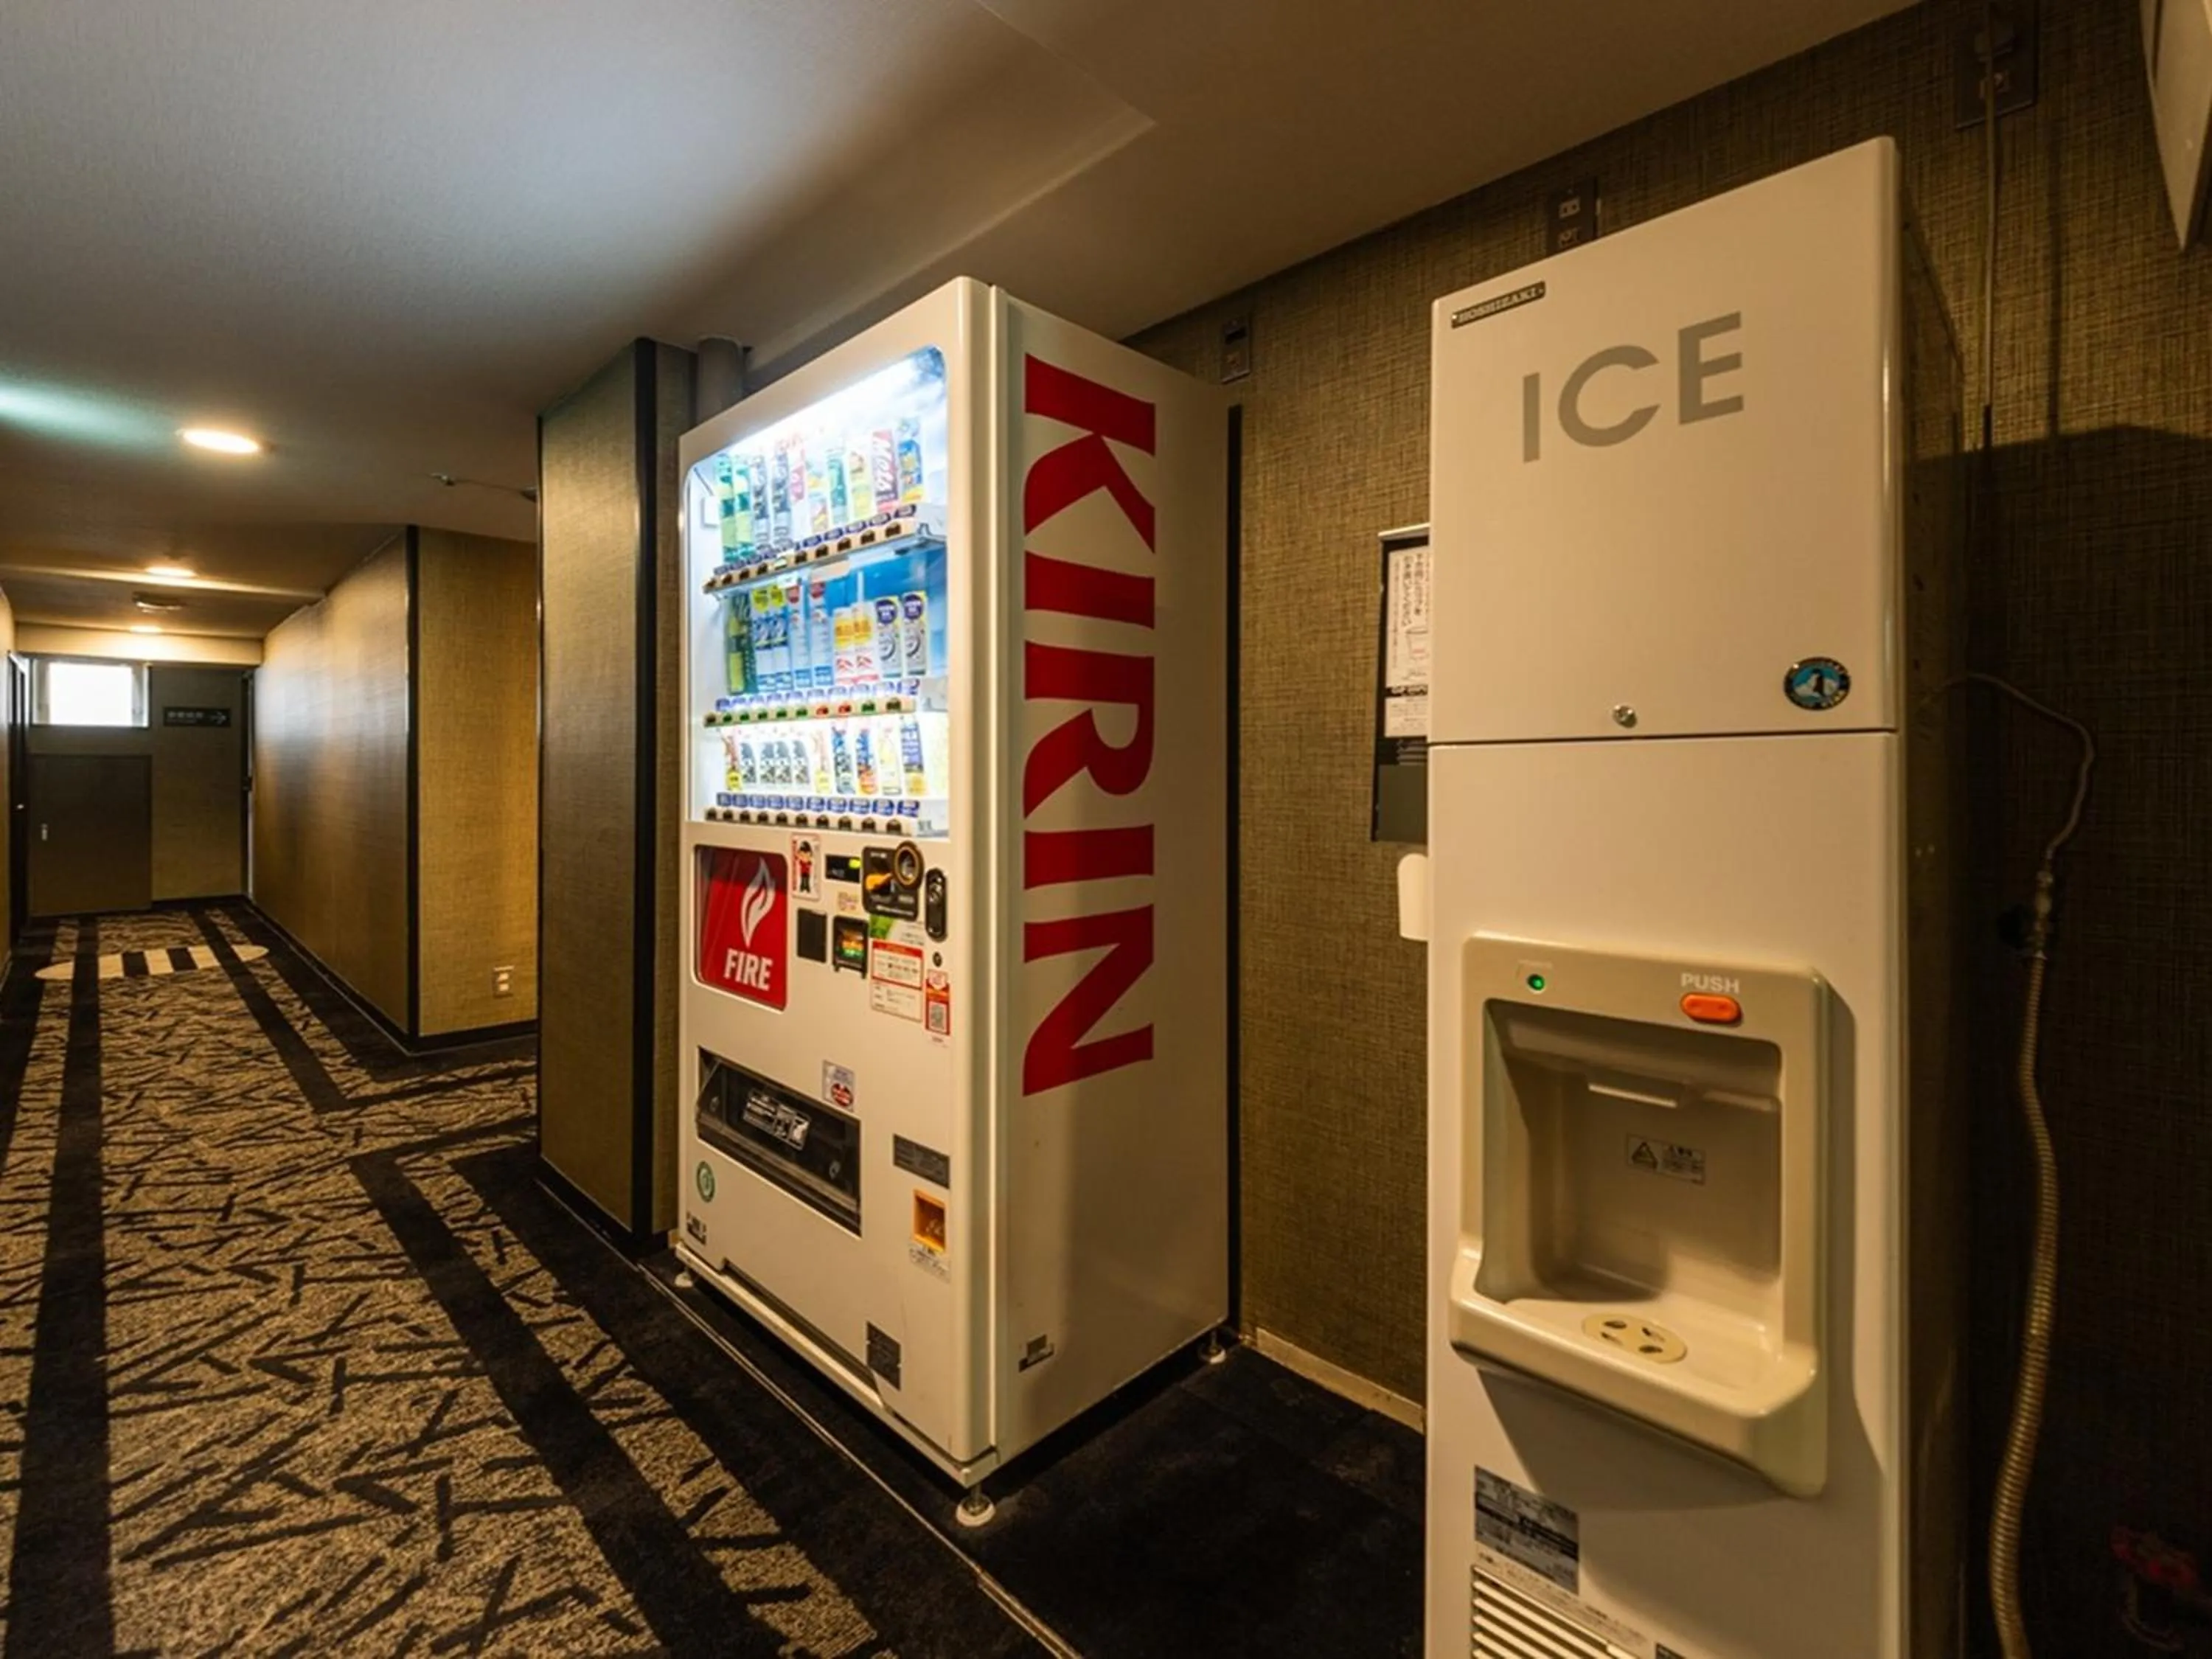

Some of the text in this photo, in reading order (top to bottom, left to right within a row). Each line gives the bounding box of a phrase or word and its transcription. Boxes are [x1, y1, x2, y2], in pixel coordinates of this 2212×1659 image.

[1523, 310, 1745, 464] ICE
[1023, 352, 1155, 1096] KIRIN
[724, 947, 773, 992] FIRE
[1681, 973, 1739, 994] PUSH
